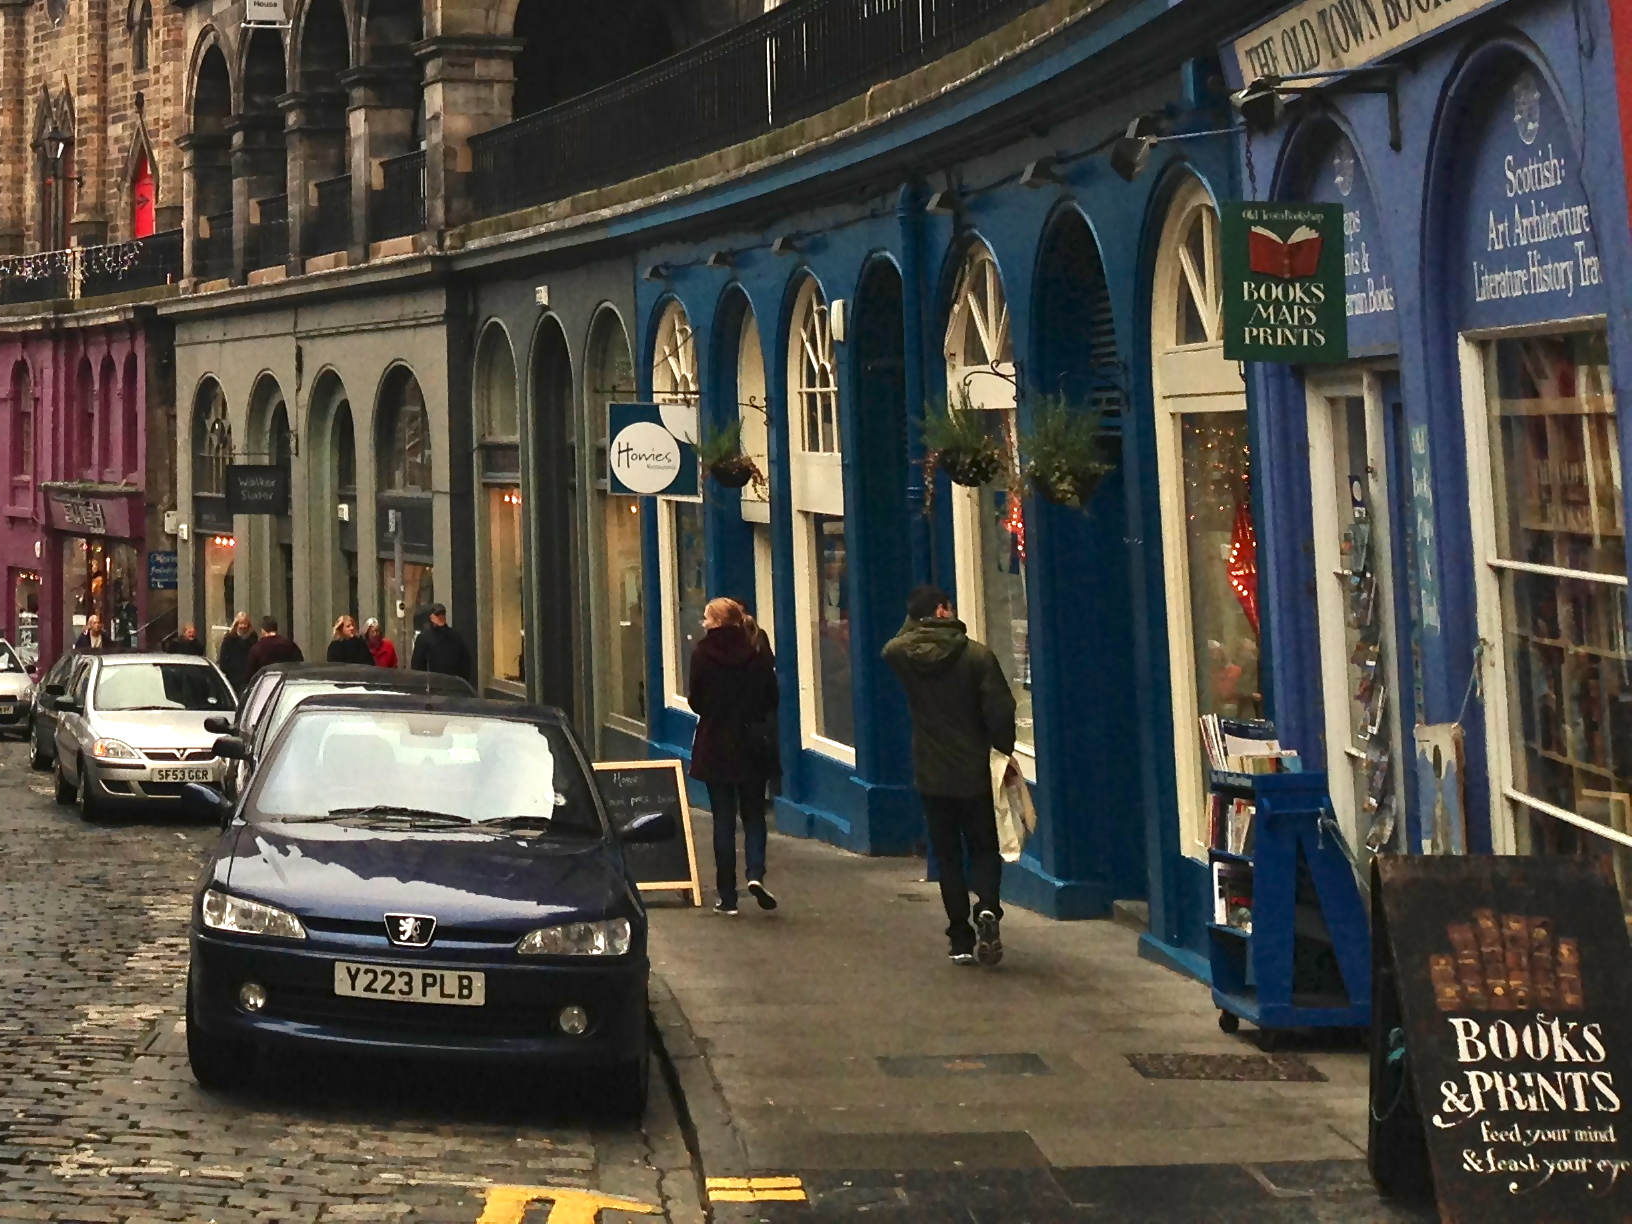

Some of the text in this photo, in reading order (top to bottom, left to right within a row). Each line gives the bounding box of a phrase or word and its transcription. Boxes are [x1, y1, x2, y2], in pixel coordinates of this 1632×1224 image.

[1245, 35, 1279, 77] THE
[1281, 18, 1321, 73] OLD
[1487, 199, 1590, 252] Art Architecture
[1472, 260, 1529, 302] Literature
[1527, 249, 1574, 298] History
[1242, 281, 1326, 304] BOOKS
[1248, 303, 1317, 326] MAPS
[1243, 327, 1326, 347] PRINTS
[345, 965, 473, 1000] Y223 PLB
[1480, 1119, 1618, 1147] feed your mind
